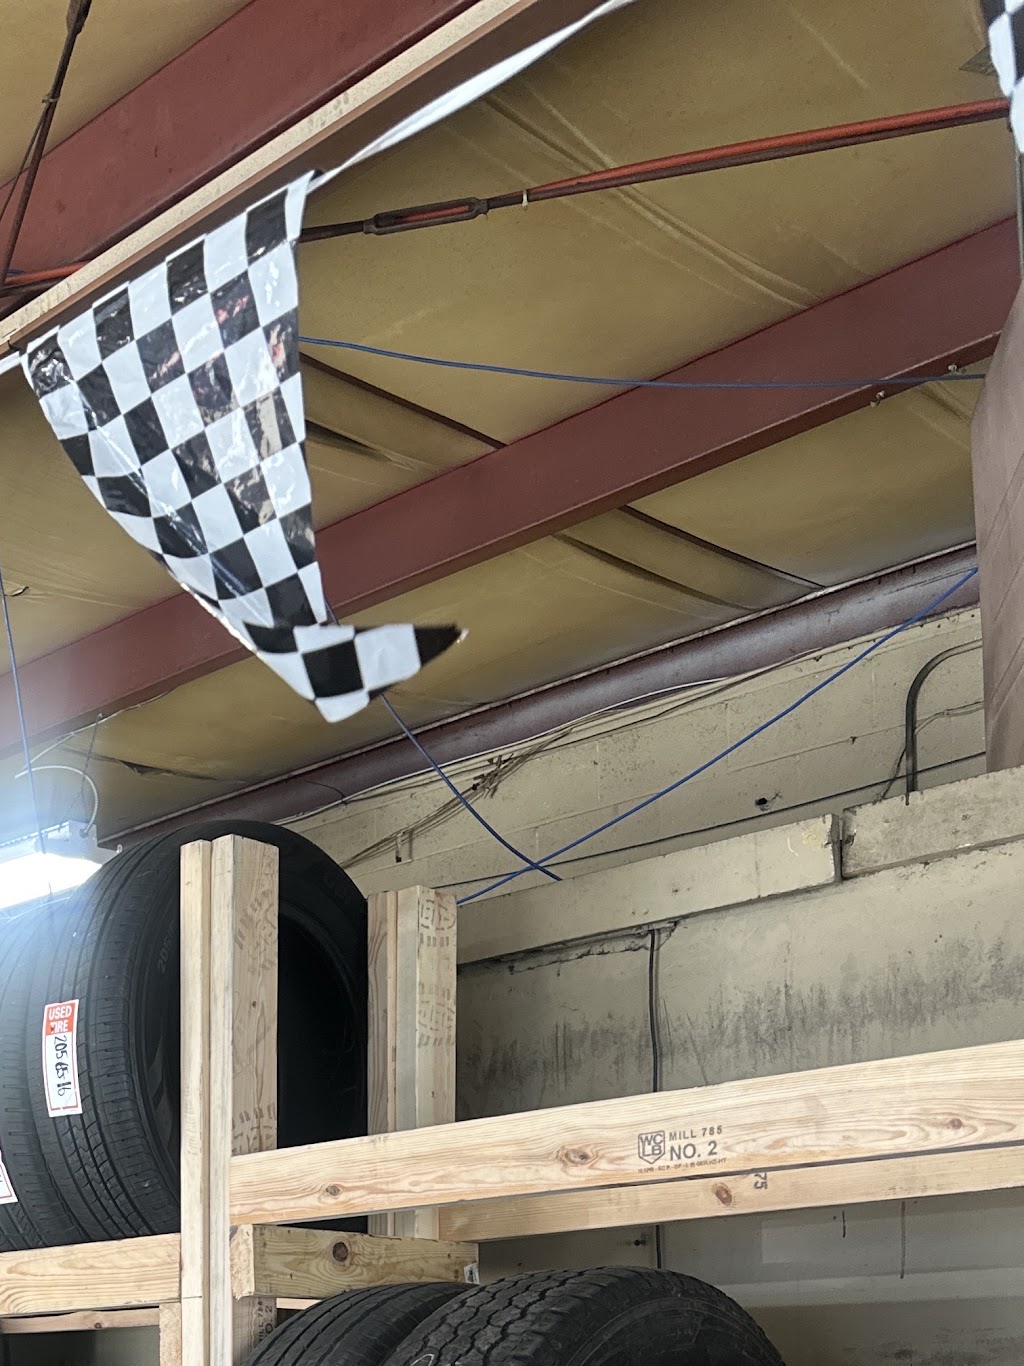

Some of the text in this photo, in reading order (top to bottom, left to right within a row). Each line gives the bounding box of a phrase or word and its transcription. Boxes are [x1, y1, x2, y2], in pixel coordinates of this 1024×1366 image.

[49, 1005, 73, 1020] USED
[50, 1019, 69, 1033] TIRE
[669, 1125, 723, 1141] MILL 785
[670, 1140, 718, 1161] NO. 2
